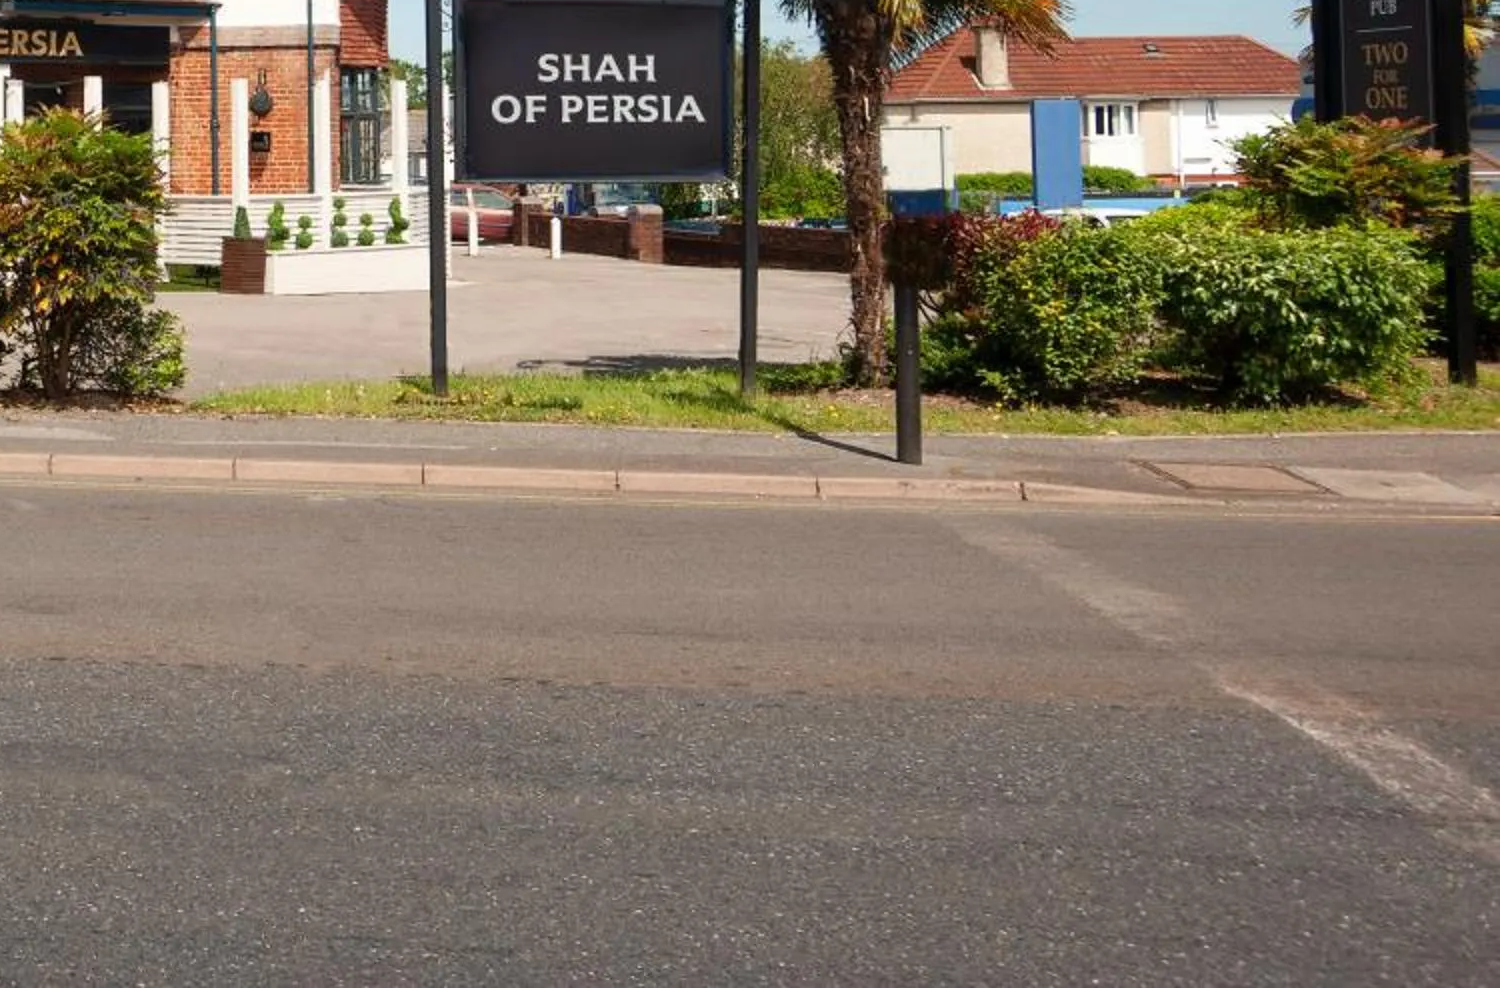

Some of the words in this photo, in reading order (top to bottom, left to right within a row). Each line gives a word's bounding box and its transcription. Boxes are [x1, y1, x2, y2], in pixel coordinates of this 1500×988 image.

[1361, 42, 1408, 65] TWO
[537, 53, 656, 83] SHAH
[1373, 69, 1399, 85] FOR
[491, 95, 547, 123] OF
[560, 95, 706, 124] PERSIA
[1365, 87, 1408, 109] ONE
